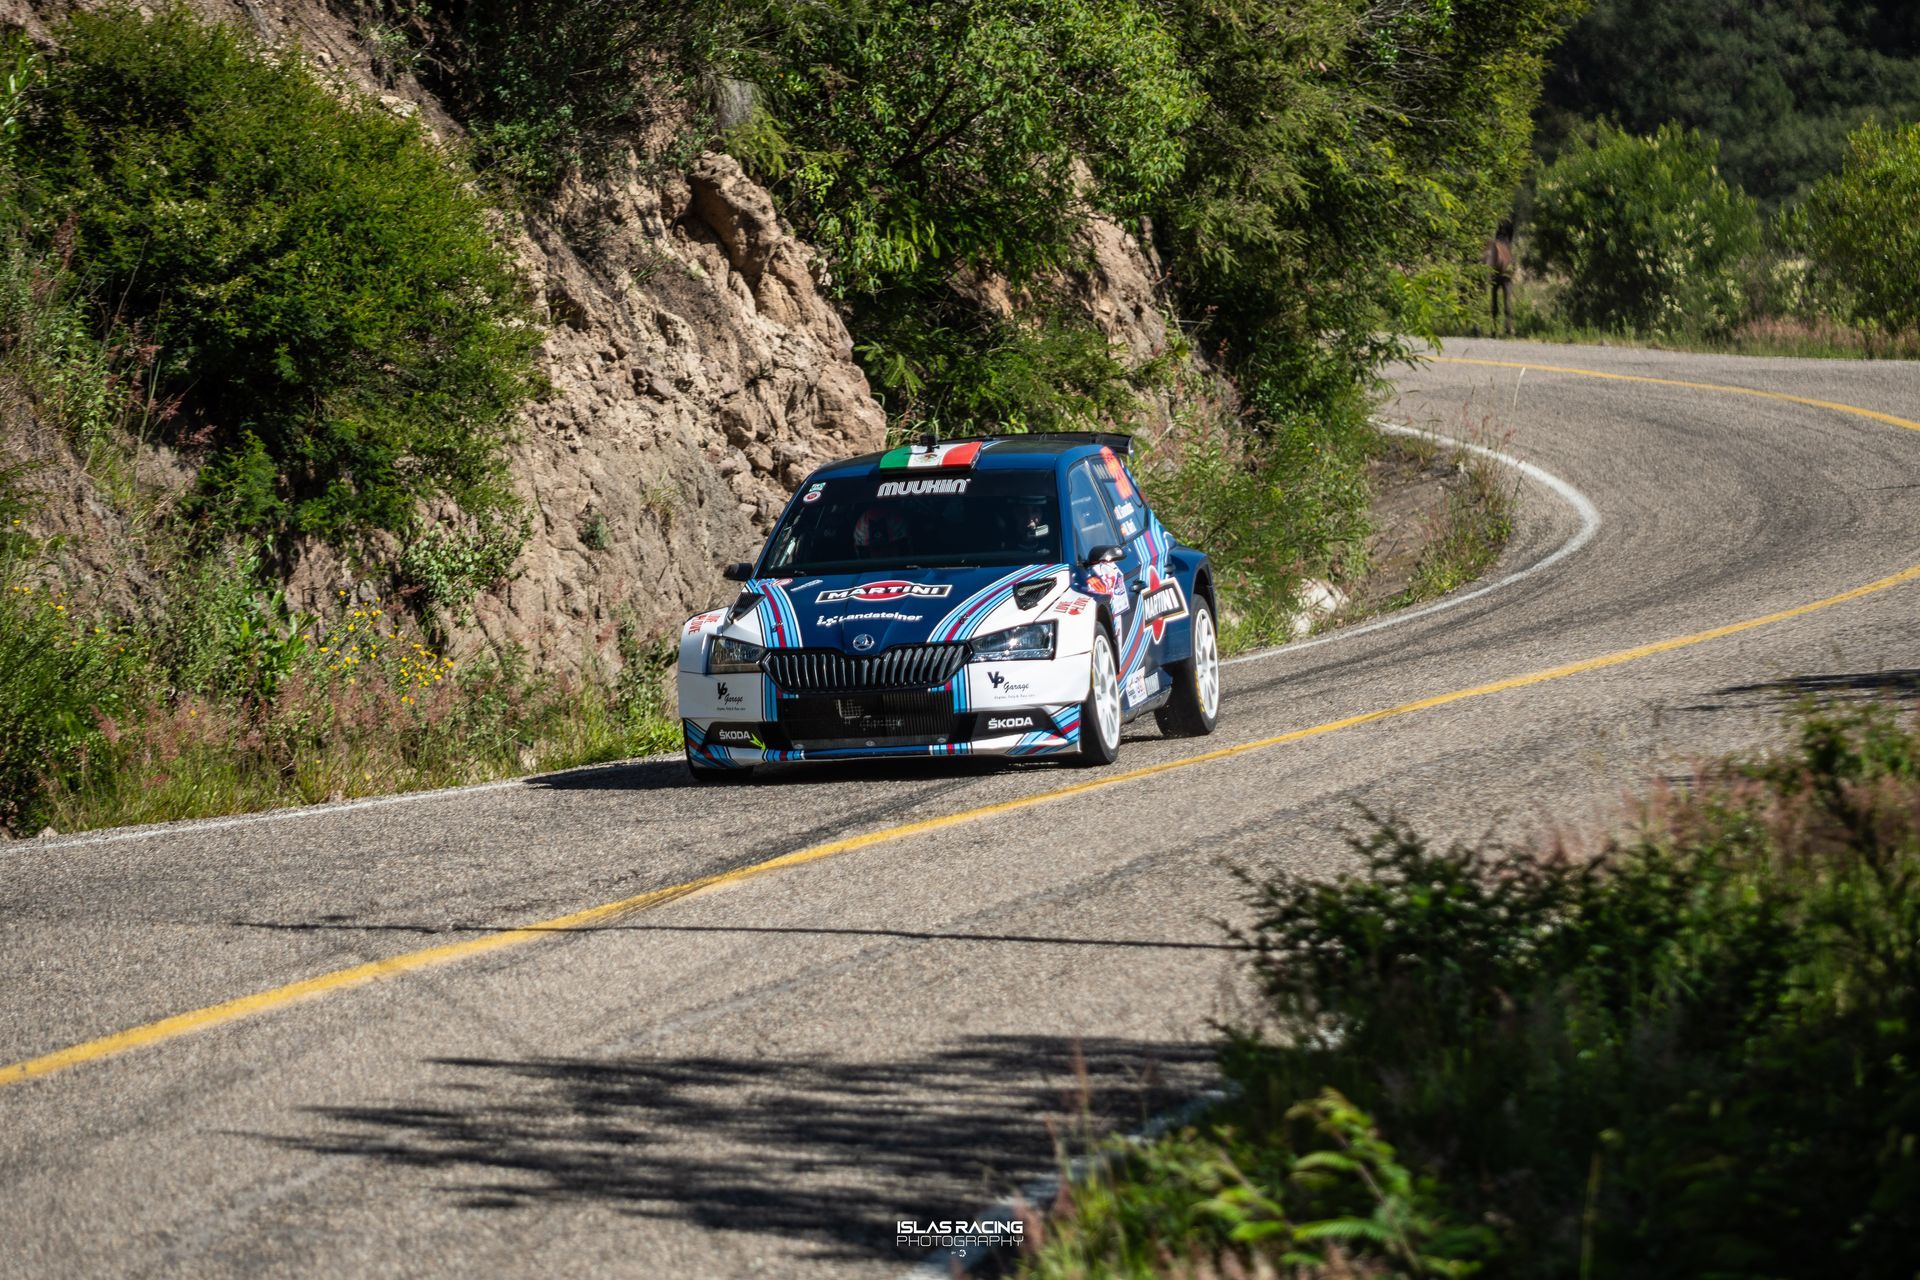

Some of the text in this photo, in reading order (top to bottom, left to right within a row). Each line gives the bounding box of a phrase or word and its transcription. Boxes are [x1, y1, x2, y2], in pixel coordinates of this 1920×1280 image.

[828, 585, 940, 600] MARTINI
[1144, 587, 1180, 621] MARTINI
[839, 612, 923, 621] Landsteiner
[1003, 681, 1029, 693] Garage
[988, 717, 1034, 729] ŠKODA
[719, 729, 751, 740] ŠKODA
